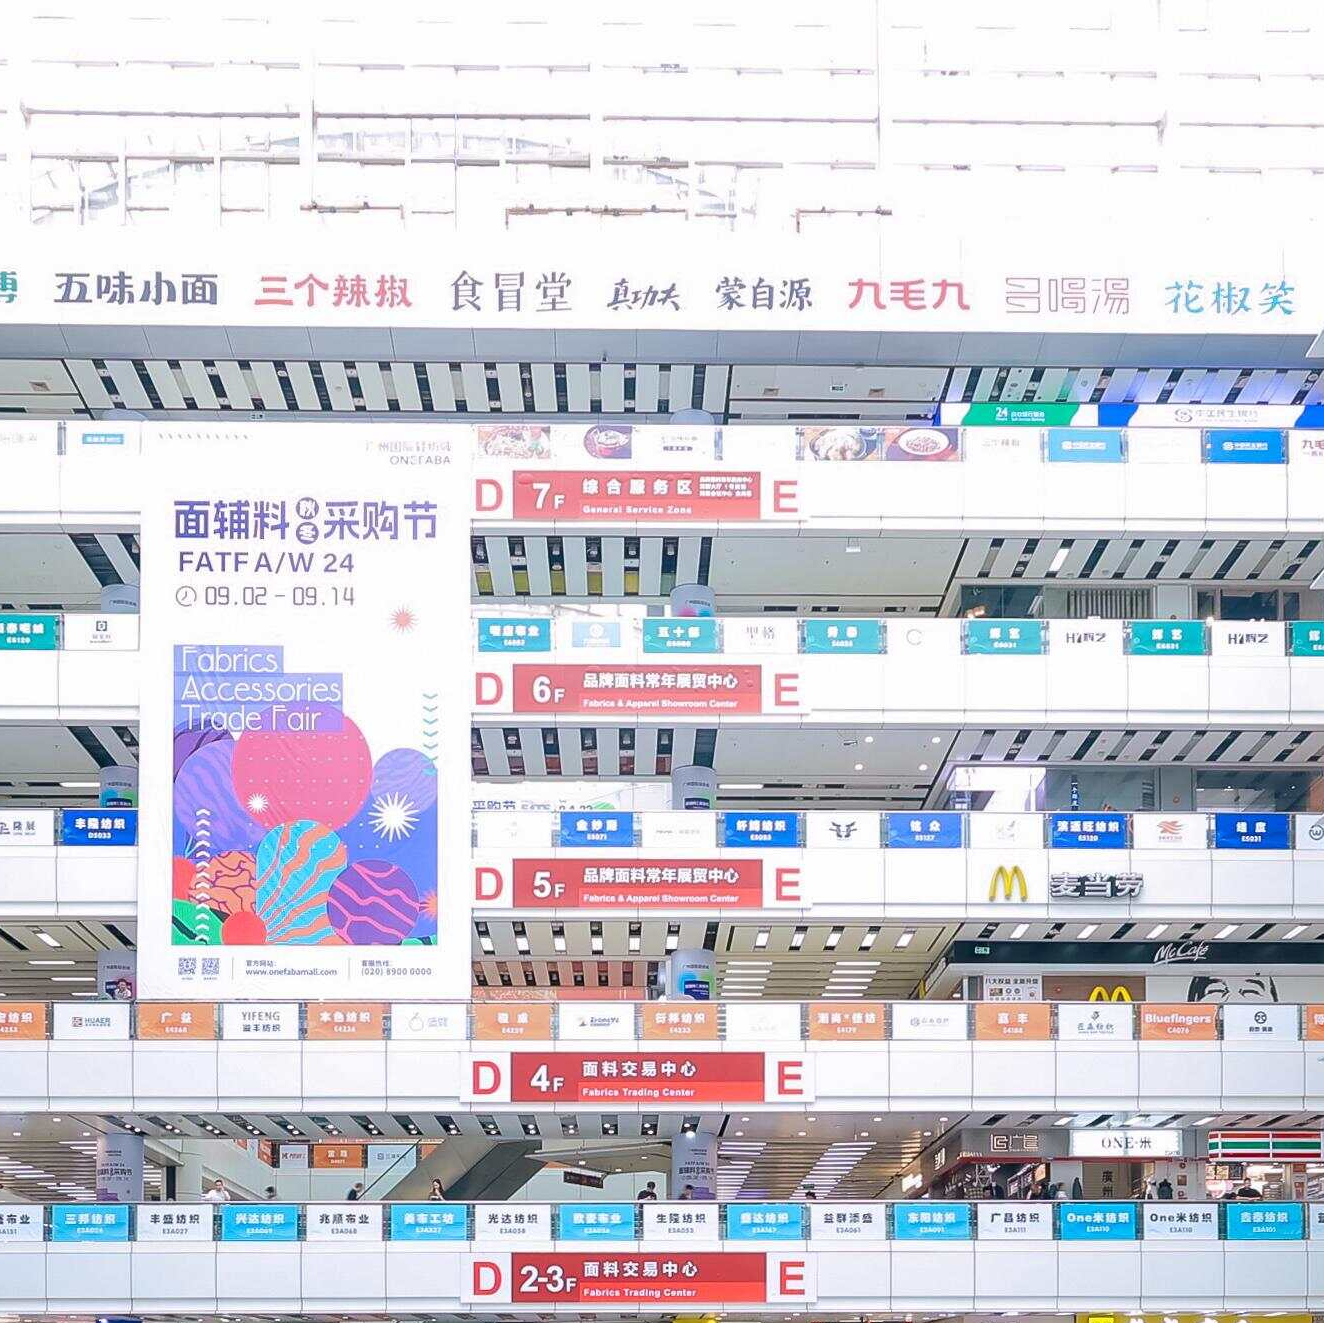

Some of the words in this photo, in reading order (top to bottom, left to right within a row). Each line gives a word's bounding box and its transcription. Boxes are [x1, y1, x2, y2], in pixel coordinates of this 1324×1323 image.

[54, 271, 219, 306] 五味小面
[253, 273, 414, 309] 三个辣椒
[450, 270, 573, 313] 食冒堂
[606, 277, 682, 312] 真功夫
[715, 276, 812, 312] 蒙自源
[848, 278, 971, 312] 九毛九
[1164, 278, 1295, 316] 花椒笑
[476, 479, 504, 512] D
[532, 483, 565, 509] 7F
[581, 478, 693, 497] 综合服务区
[774, 480, 798, 512] E
[582, 504, 623, 515] General
[626, 504, 664, 515] Service
[667, 504, 692, 515] Zone
[178, 551, 249, 574] FATF
[254, 551, 314, 574] A/W
[322, 552, 355, 574] 24
[204, 586, 268, 606] 09.02
[292, 586, 356, 606] 09.14
[181, 645, 279, 673] Fabrics
[181, 676, 342, 703] Accessories
[475, 673, 504, 705] D
[532, 676, 565, 703] 6F
[583, 672, 739, 690] 品牌面料常年展贸中心
[774, 674, 800, 707] E
[583, 698, 619, 708] Fabrics
[627, 698, 660, 709] Apparel
[662, 698, 707, 708] Showroom
[708, 698, 738, 708] Center
[181, 704, 263, 731] Trade
[271, 704, 322, 731] Fair
[475, 867, 504, 901] D
[533, 871, 565, 898] 5F
[583, 866, 740, 884] 品牌面料常年展贸中心
[775, 868, 802, 902] E
[1050, 872, 1144, 899] 麦当劳
[583, 893, 619, 904] Fabrics
[627, 893, 660, 905] Apparel
[662, 893, 708, 904] Showroom
[709, 893, 739, 904] Center
[1153, 941, 1211, 964] McCafé
[241, 1011, 281, 1022] YIFENG
[1143, 1012, 1212, 1025] Bluefingers
[472, 1060, 502, 1095] D
[530, 1064, 565, 1092] 4F
[582, 1060, 697, 1078] 面料交易中心
[777, 1060, 804, 1095] E
[582, 1087, 619, 1098] Fabrics
[622, 1087, 660, 1099] Trading
[662, 1087, 696, 1098] Center
[149, 1213, 201, 1225] 丰盛纺织
[487, 1212, 539, 1225] 光达纺织
[990, 1212, 1041, 1224] 广昌纺织
[1066, 1212, 1130, 1224] One米纺织
[1149, 1212, 1213, 1224] One米纺织
[473, 1261, 503, 1296] D
[519, 1264, 577, 1294] 2-3F
[583, 1260, 698, 1278] 面料交易中心
[779, 1261, 806, 1296] E
[583, 1287, 620, 1298] Fabrics
[623, 1287, 661, 1299] Trading
[663, 1287, 697, 1298] Center
